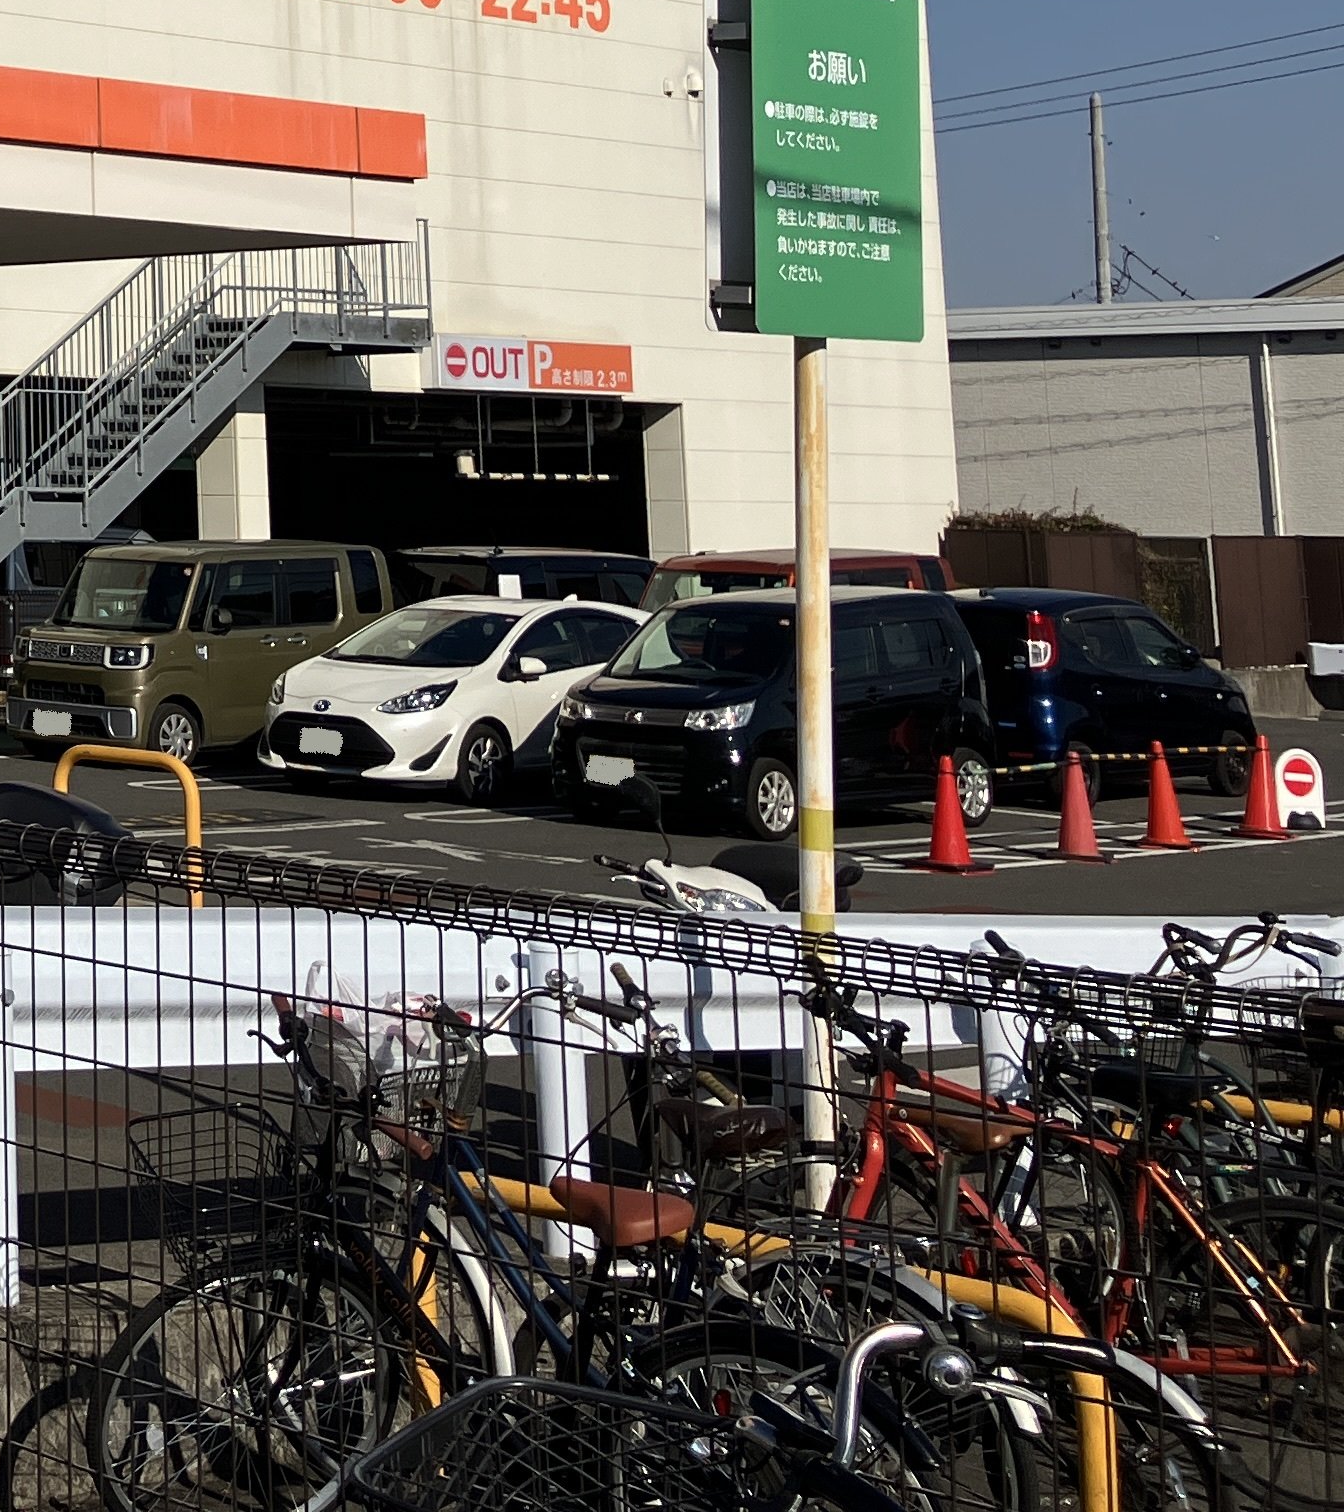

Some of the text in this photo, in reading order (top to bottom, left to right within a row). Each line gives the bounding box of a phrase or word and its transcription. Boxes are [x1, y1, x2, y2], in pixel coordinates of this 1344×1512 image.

[808, 49, 866, 85] お願い
[776, 129, 840, 152] してください。
[778, 264, 823, 283] ください。
[472, 345, 524, 380] OUT
[533, 343, 553, 385] P
